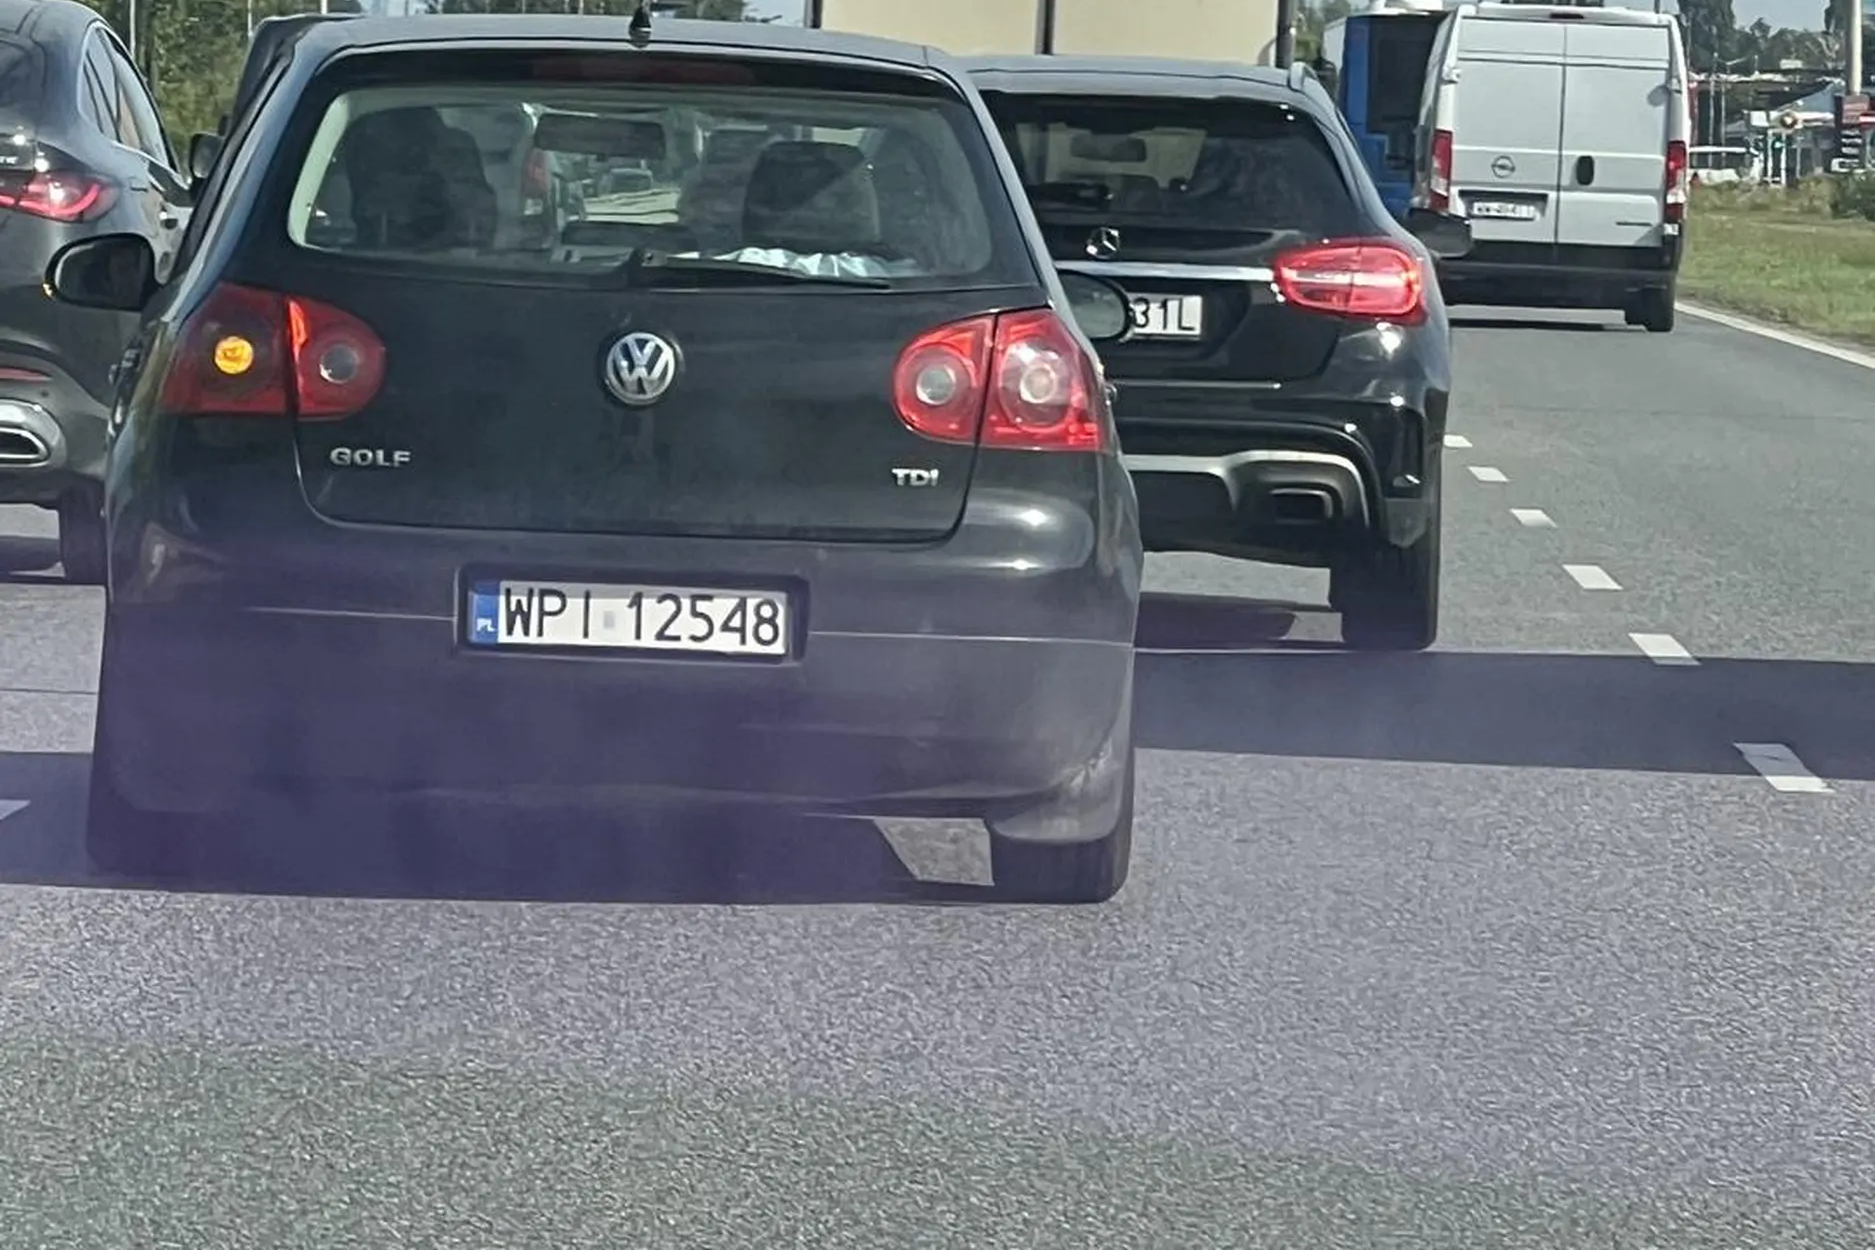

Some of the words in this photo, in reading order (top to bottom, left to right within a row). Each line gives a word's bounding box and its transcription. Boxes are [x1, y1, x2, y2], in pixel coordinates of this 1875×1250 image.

[1128, 296, 1196, 331] 31L
[329, 447, 412, 467] GOLF
[891, 468, 939, 487] TDI
[476, 617, 496, 632] PL
[503, 587, 591, 640] WPI
[626, 591, 781, 647] 12548
